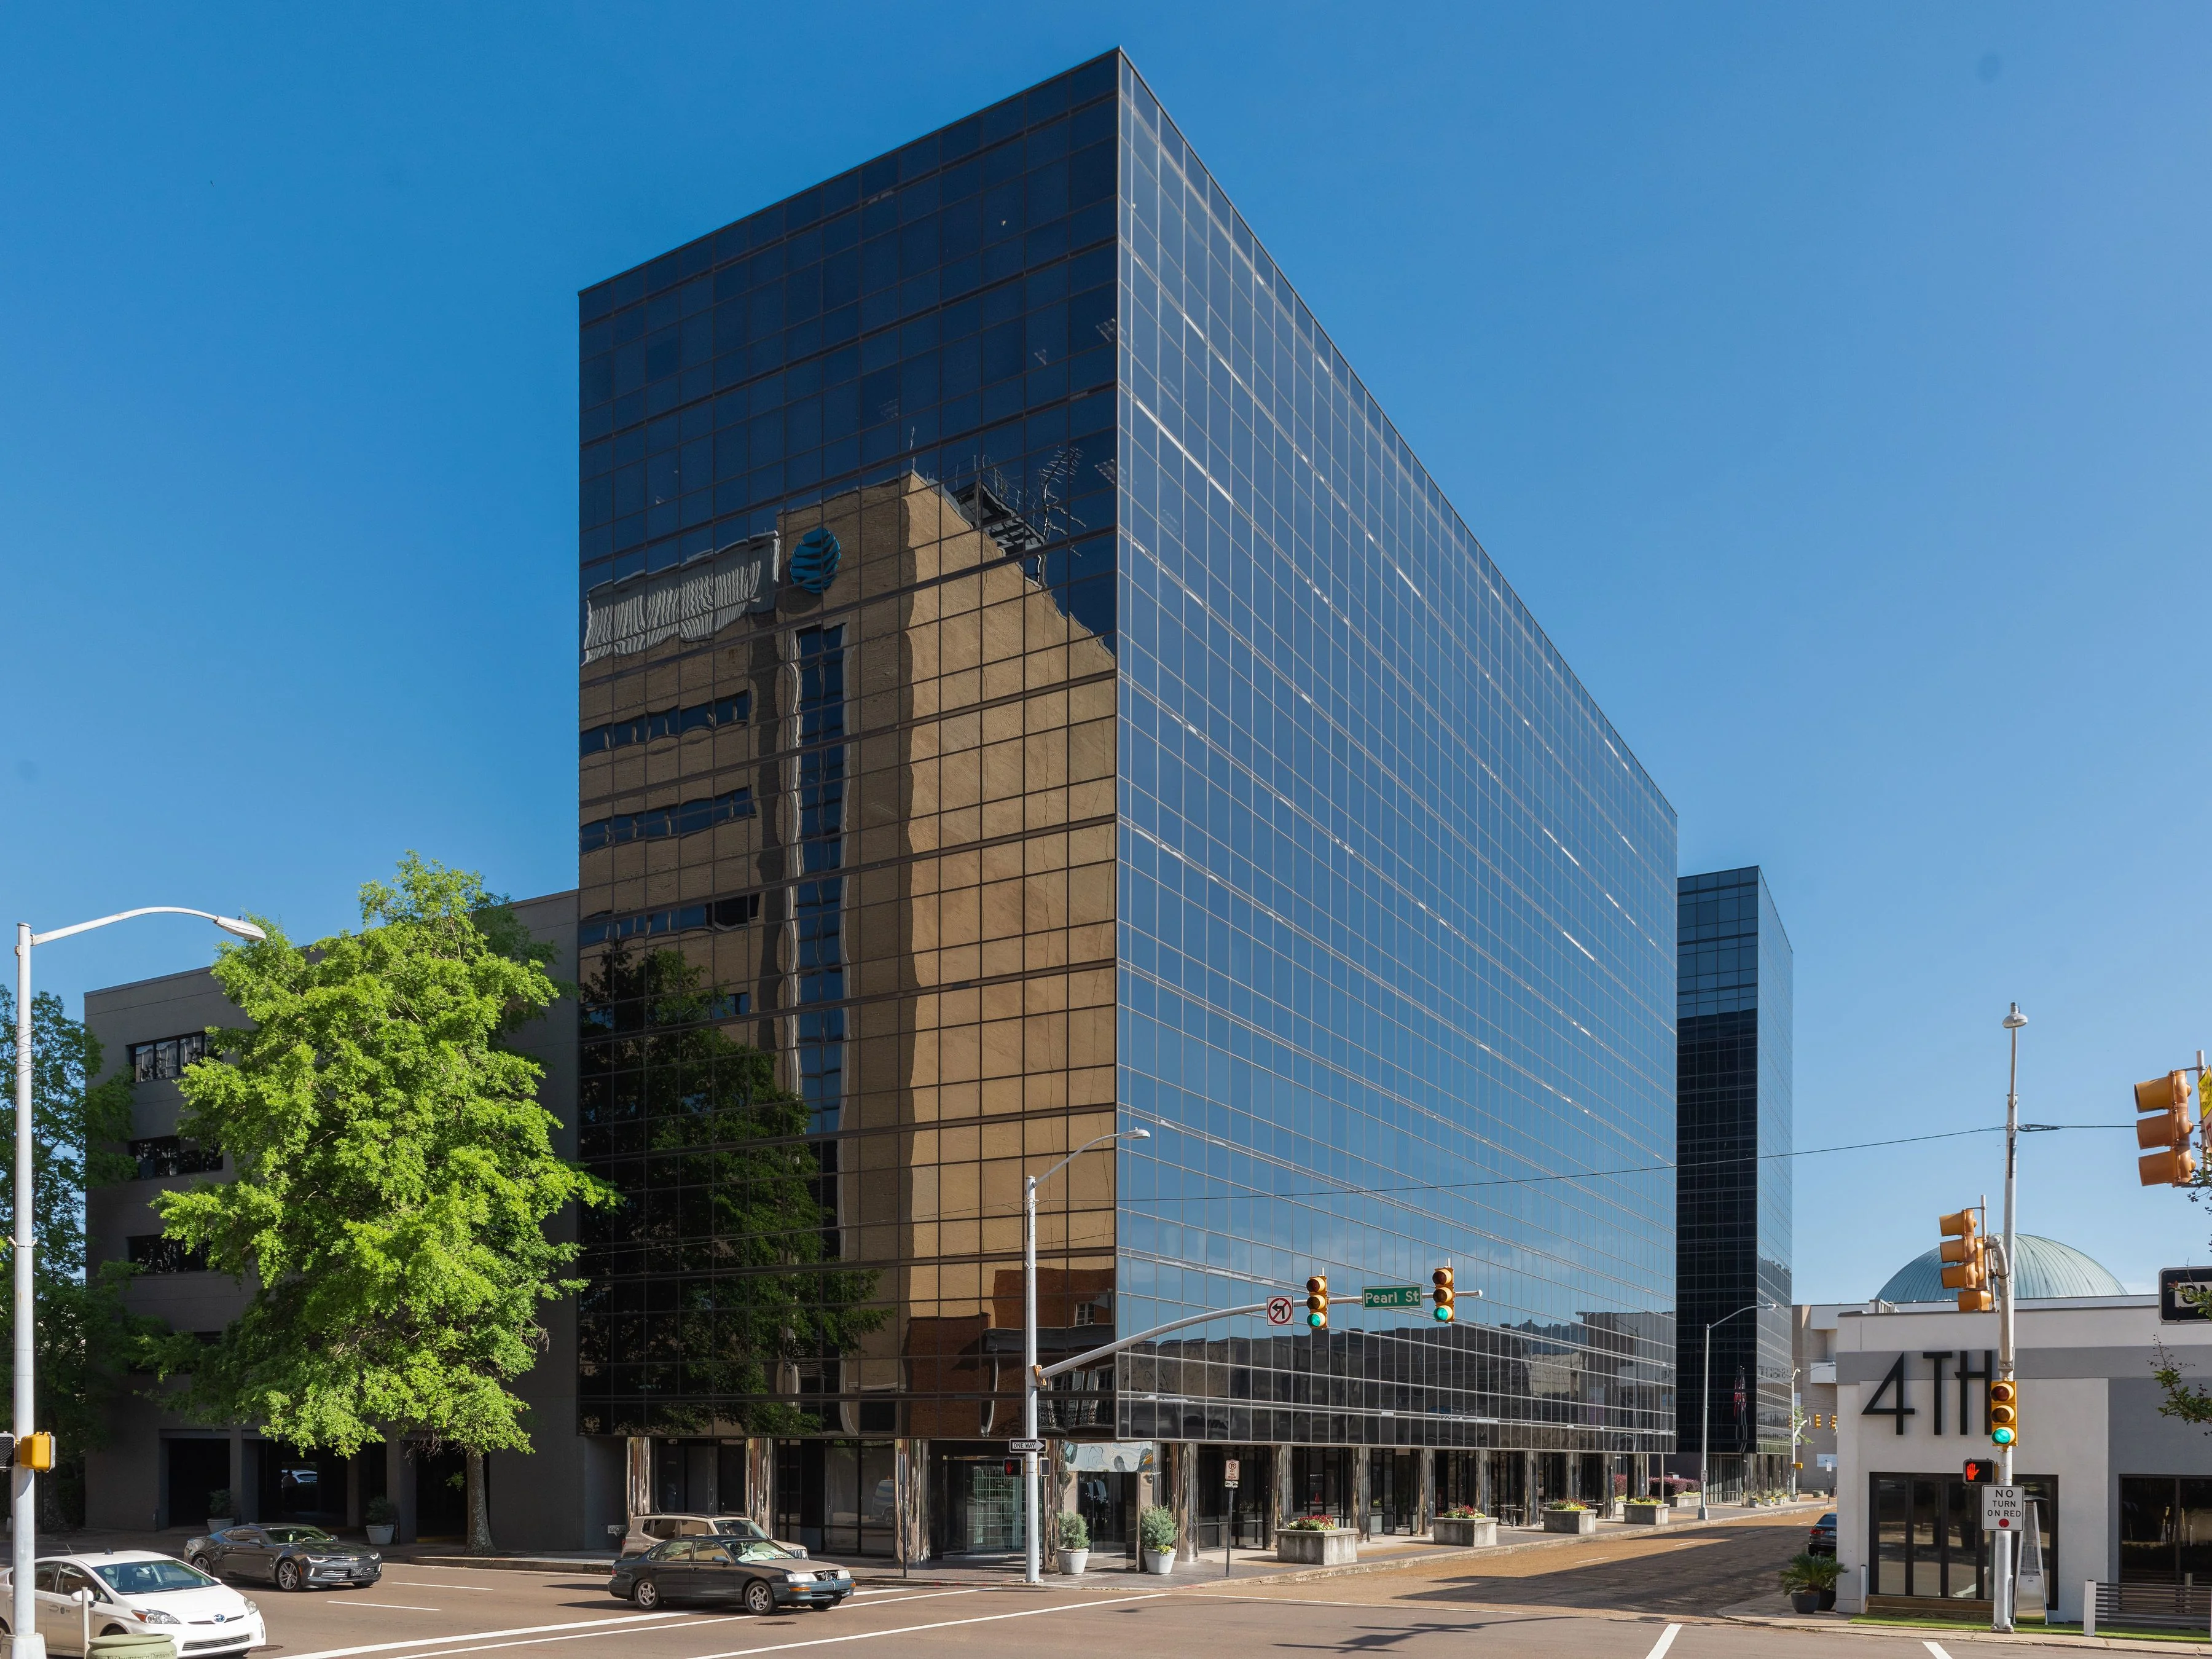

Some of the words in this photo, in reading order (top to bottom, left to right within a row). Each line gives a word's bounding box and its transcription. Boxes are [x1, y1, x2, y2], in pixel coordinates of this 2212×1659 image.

[1365, 1292, 1397, 1304] Pearl
[1405, 1290, 1419, 1303] St
[1861, 1351, 1992, 1435] 4TH
